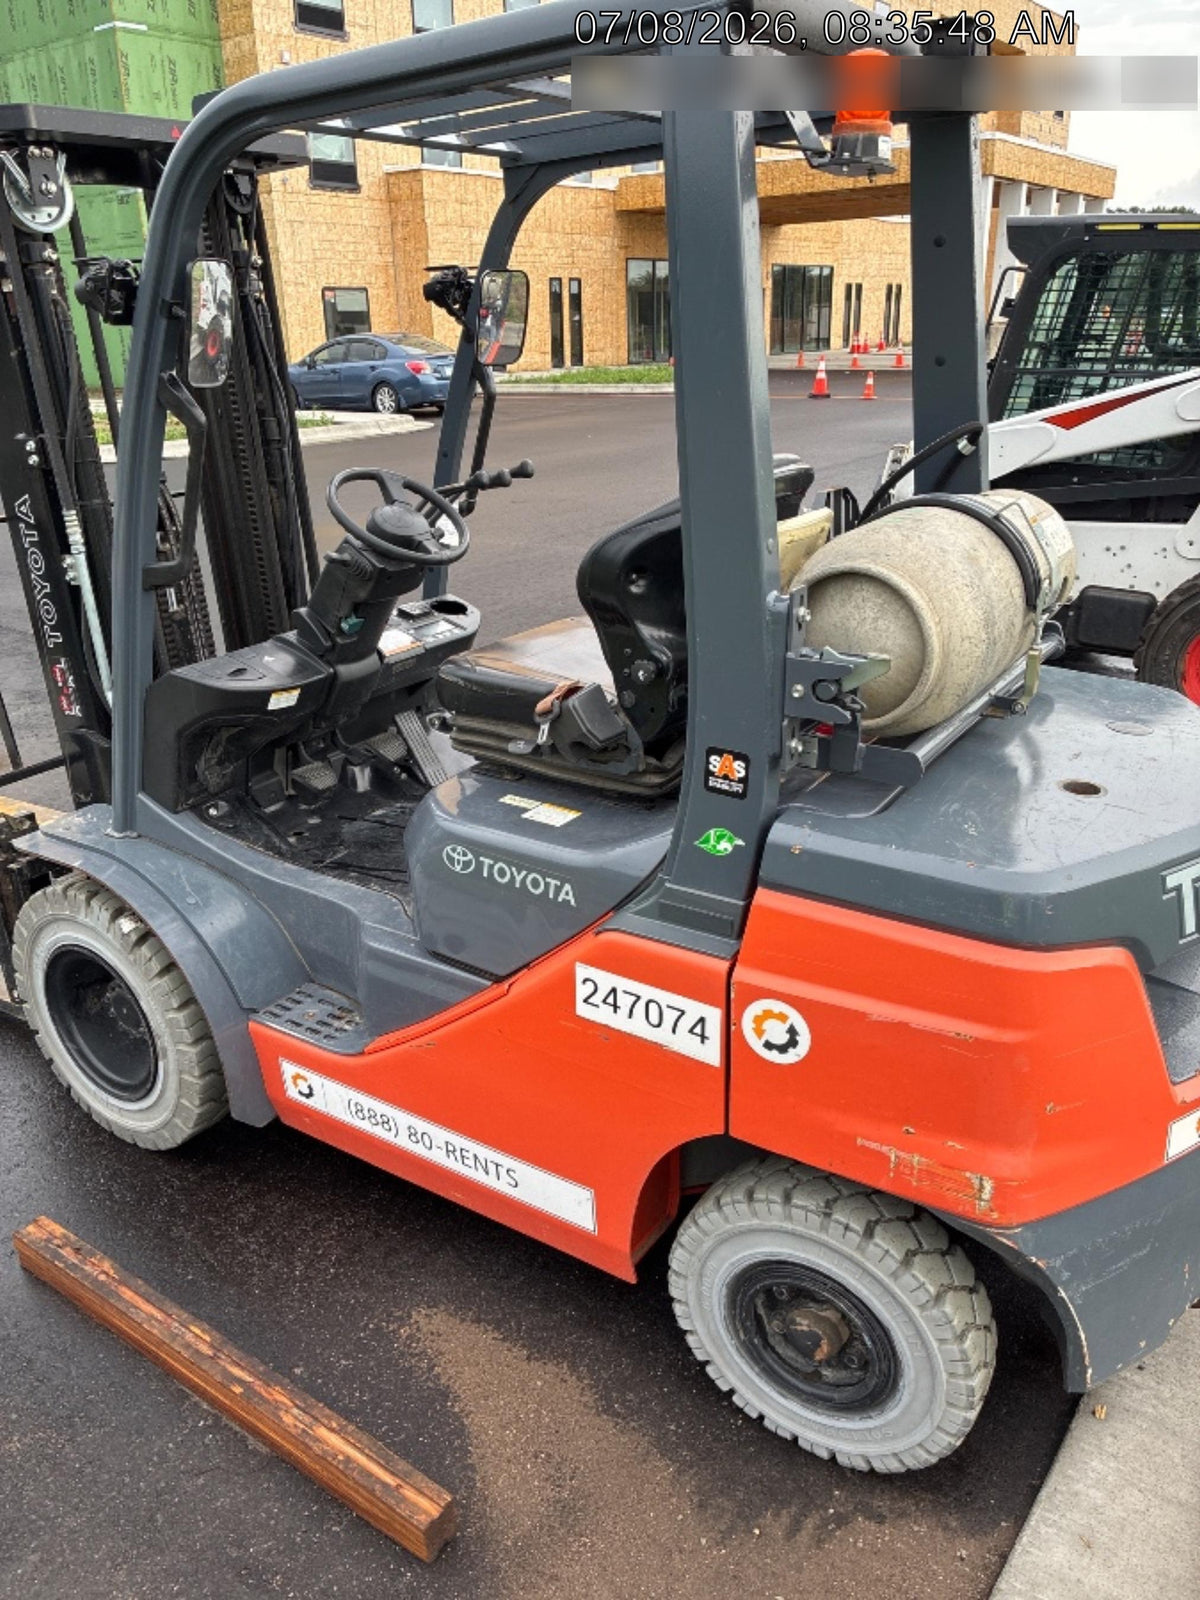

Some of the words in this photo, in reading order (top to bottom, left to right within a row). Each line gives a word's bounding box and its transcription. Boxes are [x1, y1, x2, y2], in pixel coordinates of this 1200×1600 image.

[14, 494, 63, 648] TOYOTA
[709, 753, 746, 781] SAS
[479, 856, 576, 907] TOYOTA
[582, 977, 710, 1044] 247074
[347, 1097, 400, 1138] (888)
[407, 1124, 519, 1188] 80-RENTS
